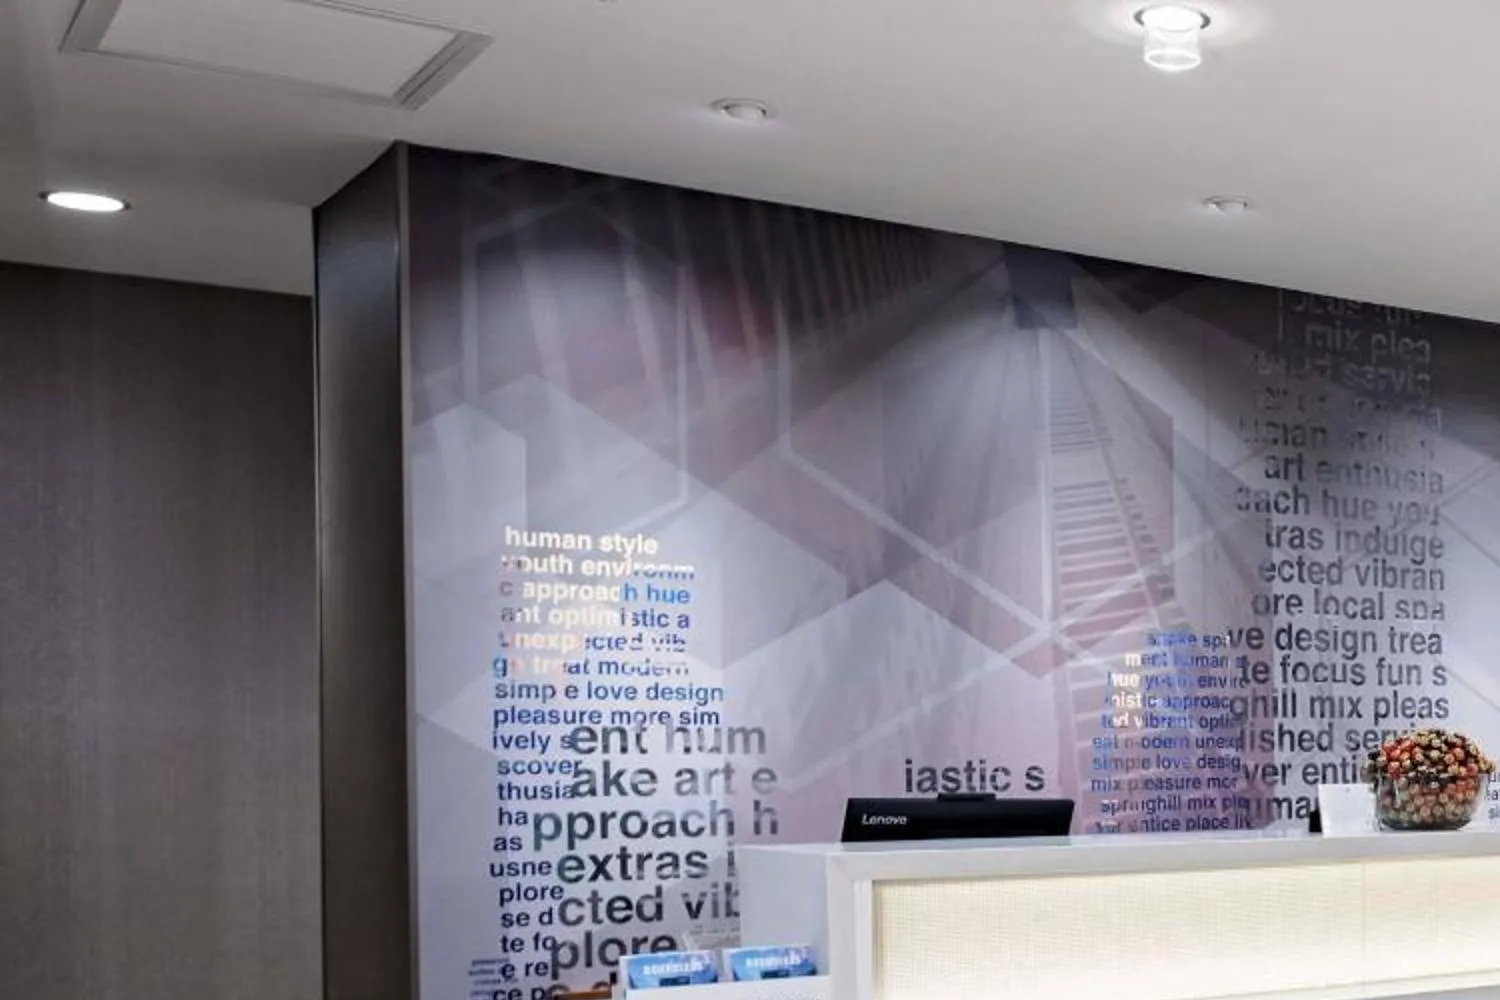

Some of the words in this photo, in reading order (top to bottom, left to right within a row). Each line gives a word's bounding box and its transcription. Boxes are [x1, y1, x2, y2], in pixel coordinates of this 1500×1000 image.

[505, 526, 592, 550] human
[599, 533, 658, 559] style
[1355, 558, 1445, 592] vibran
[647, 582, 690, 604] hue
[1275, 621, 1378, 661] design
[1388, 626, 1443, 655] trea
[1279, 654, 1367, 687] focus
[1376, 657, 1423, 687] fun
[1432, 664, 1448, 687] s
[587, 681, 638, 701] love
[646, 682, 725, 707] design
[1309, 689, 1363, 719] mix
[1373, 690, 1450, 726] pleas
[492, 705, 602, 729] pleasure
[679, 708, 721, 726] sim
[569, 722, 648, 756] ent
[665, 720, 766, 755] hum
[573, 760, 659, 798] ake
[674, 762, 736, 798] art
[751, 767, 778, 796] e
[904, 758, 1012, 794] iastic
[1024, 765, 1046, 792] s
[498, 806, 529, 827] ha
[533, 800, 736, 851] pproach
[753, 800, 779, 836] h
[861, 813, 908, 826] Lenovo
[493, 836, 523, 853] as
[489, 860, 553, 878] usne
[557, 845, 710, 885] extras
[499, 882, 565, 908] plore
[558, 884, 665, 927] cted
[501, 911, 531, 929] se
[538, 905, 553, 926] d
[501, 932, 525, 953] te
[551, 930, 678, 981] plore
[524, 959, 549, 978] re
